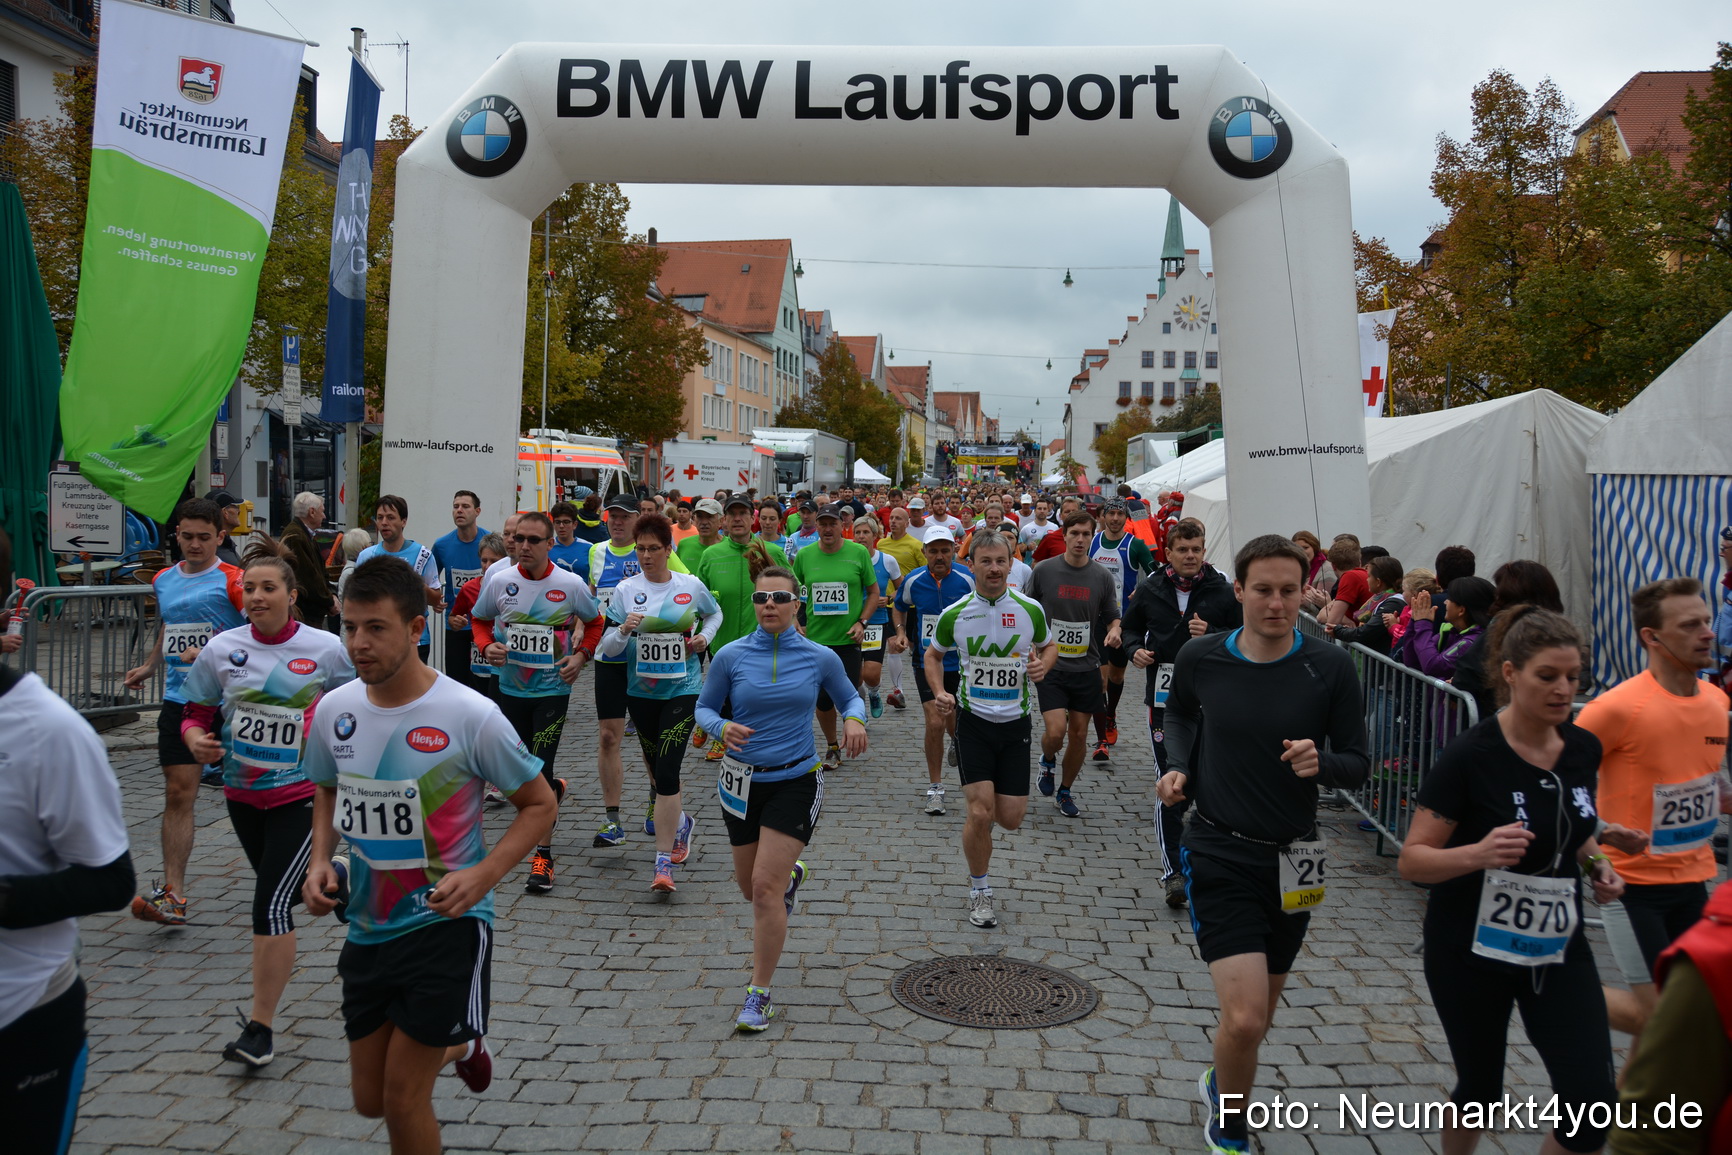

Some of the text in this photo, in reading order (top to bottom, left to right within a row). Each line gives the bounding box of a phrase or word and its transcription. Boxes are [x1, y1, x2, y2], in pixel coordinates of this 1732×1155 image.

[557, 58, 1180, 136] BMW Laufsport
[456, 97, 521, 124] BMW
[1215, 97, 1283, 125] BMW
[286, 334, 296, 359] P
[332, 383, 365, 396] railon
[384, 438, 494, 454] www.bmw-laufsport.de
[1248, 443, 1364, 459] www.bmw-laufsport.de
[53, 481, 90, 491] Fußgänger
[65, 492, 110, 500] Lammsbräu-
[62, 502, 113, 511] Kreuzung über
[65, 522, 110, 531] Kaserngasse
[816, 590, 845, 603] 2743
[510, 634, 549, 652] 3018
[1057, 629, 1083, 644] 285
[641, 643, 681, 661] 3019
[291, 660, 315, 671] Hervis
[645, 664, 675, 672] ALEX
[974, 668, 1018, 687] 2188
[979, 690, 1011, 699] Reinhard
[237, 705, 292, 720] PARTL Neumarkt
[237, 716, 297, 746] 2810
[411, 731, 445, 746] Hervis
[245, 746, 281, 760] Martina
[333, 745, 355, 754] PARTL
[357, 786, 402, 799] Neumarkt
[1661, 791, 1715, 826] 2587
[341, 798, 414, 836] 3118
[1489, 892, 1569, 934] 2670
[1510, 937, 1544, 954] Katja
